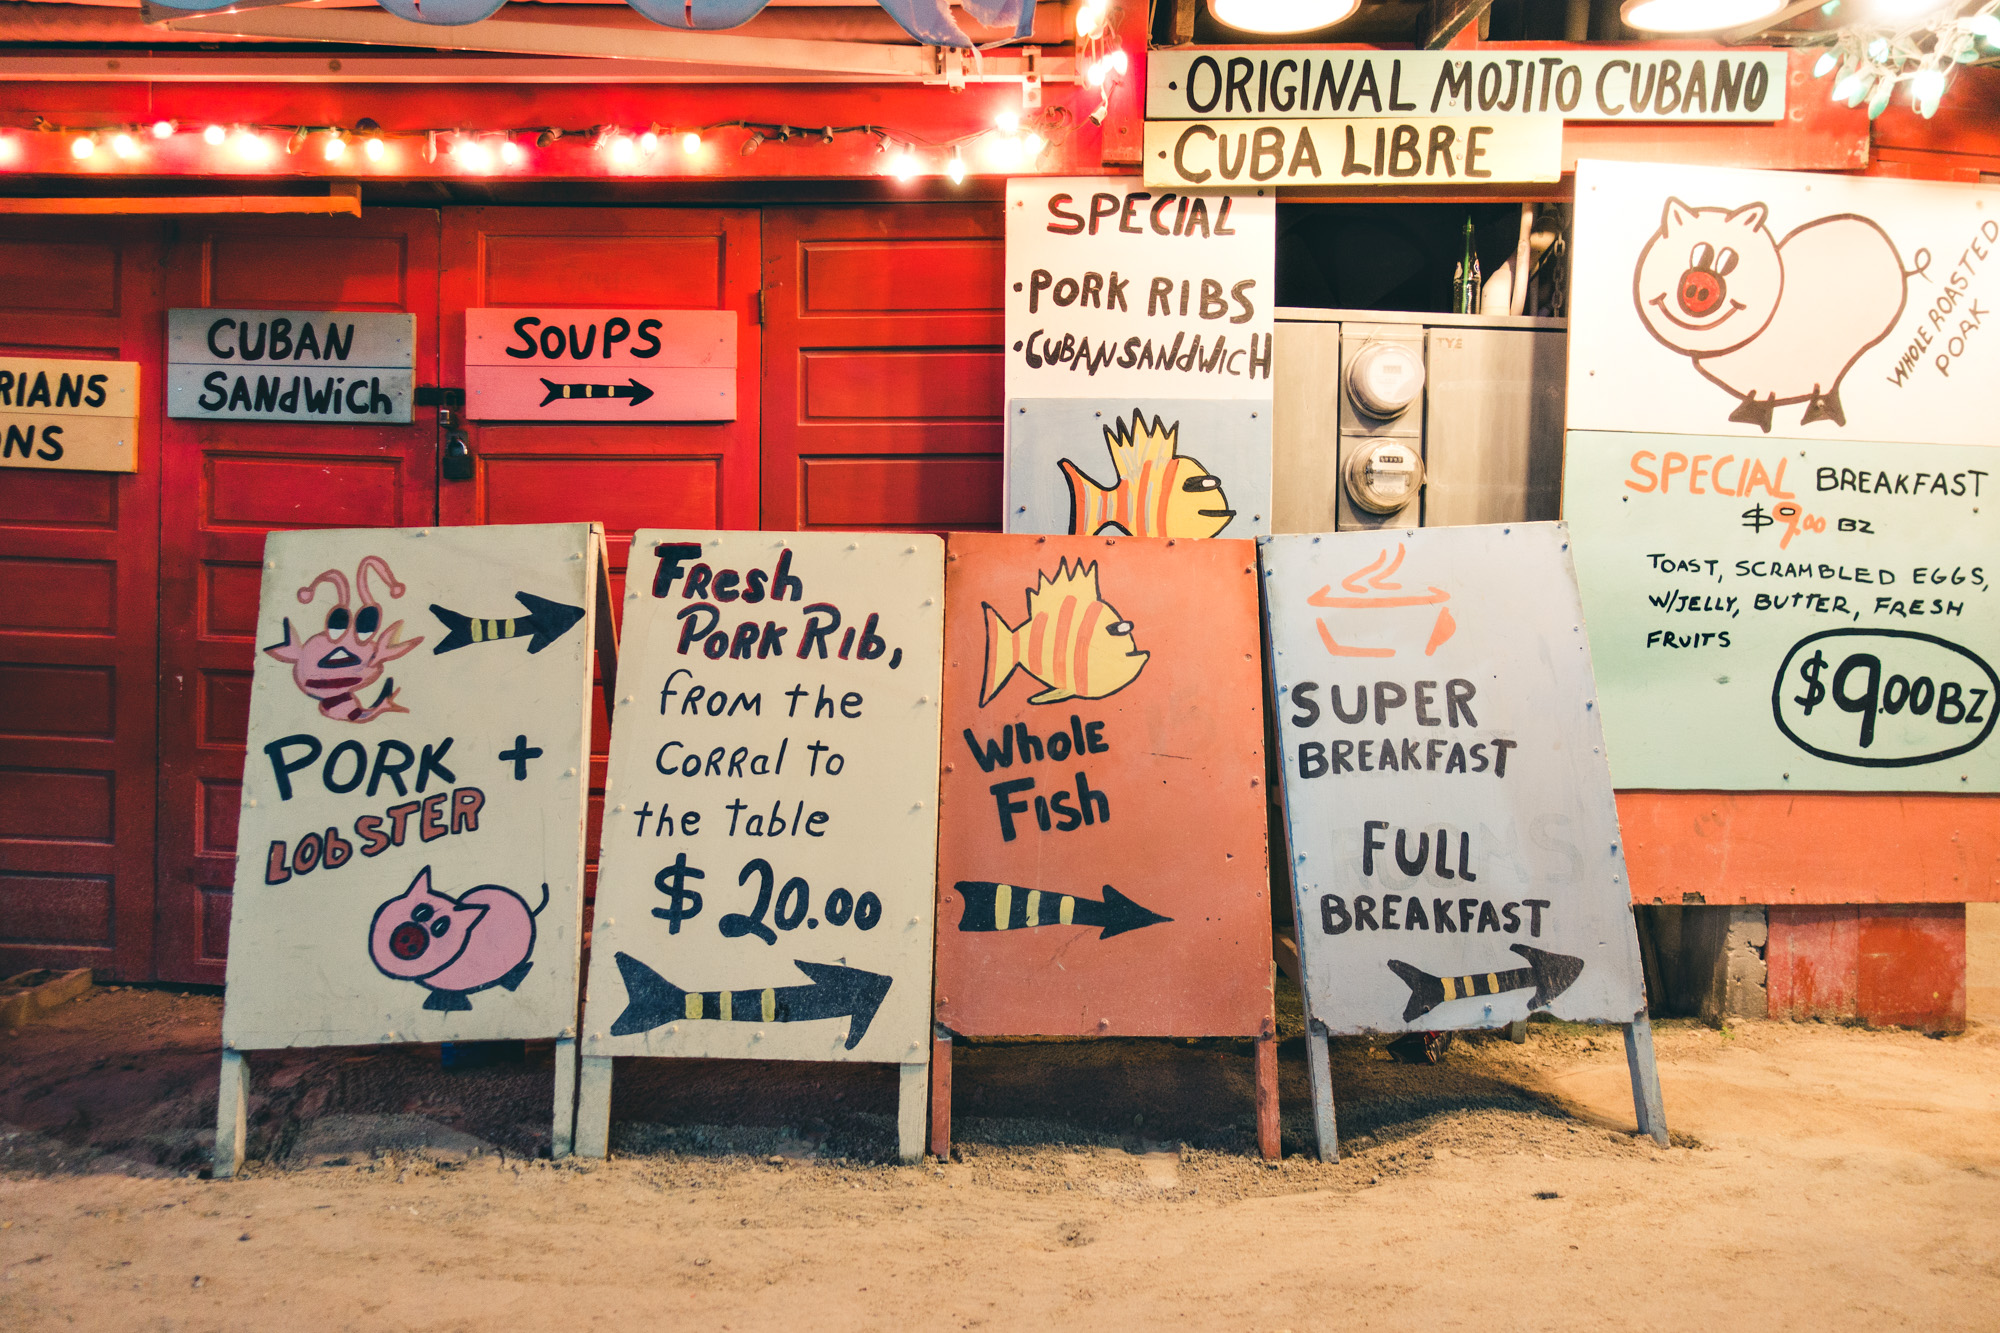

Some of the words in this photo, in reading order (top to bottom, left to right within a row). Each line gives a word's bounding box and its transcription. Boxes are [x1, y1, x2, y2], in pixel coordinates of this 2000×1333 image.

[1185, 54, 1418, 114] ORIGINAL
[1429, 57, 1582, 114] MOJITO
[1598, 59, 1769, 115] CUBANO
[1173, 126, 1322, 182] CUBA
[1341, 124, 1494, 178] LIBRE
[1046, 191, 1237, 239] SPECIAL
[1029, 268, 1130, 315] PORK
[1147, 276, 1257, 325] RIBS
[1886, 325, 1934, 388] WHOLE
[1927, 219, 1999, 333] ROASTED
[206, 316, 355, 362] CUBAN
[505, 316, 663, 361] SOUPS
[1934, 298, 1990, 378] PORK
[0, 370, 109, 408] RIANS
[0, 424, 64, 462] NS
[1625, 450, 1796, 499] SPECIAL
[1816, 466, 1989, 498] BREAKFAST
[1741, 501, 1828, 550] $9.00
[1837, 517, 1875, 535] BZ
[1646, 553, 1723, 584] TOAST,
[1735, 560, 1896, 586] SCRAMBLED
[1912, 566, 1990, 592] EGGS,
[1648, 588, 1740, 619] W/JELLY,
[1753, 591, 1860, 622] BUTTER,
[1873, 596, 1964, 619] FRESH
[1646, 629, 1732, 650] FRUITS
[784, 683, 864, 719] the
[1291, 678, 1479, 729] SUPER
[263, 733, 457, 801] PORK
[1298, 737, 1518, 780] BREAKFAST
[633, 801, 701, 838] the
[1362, 820, 1477, 883] FULL
[1320, 893, 1551, 938] BREAKFAST
